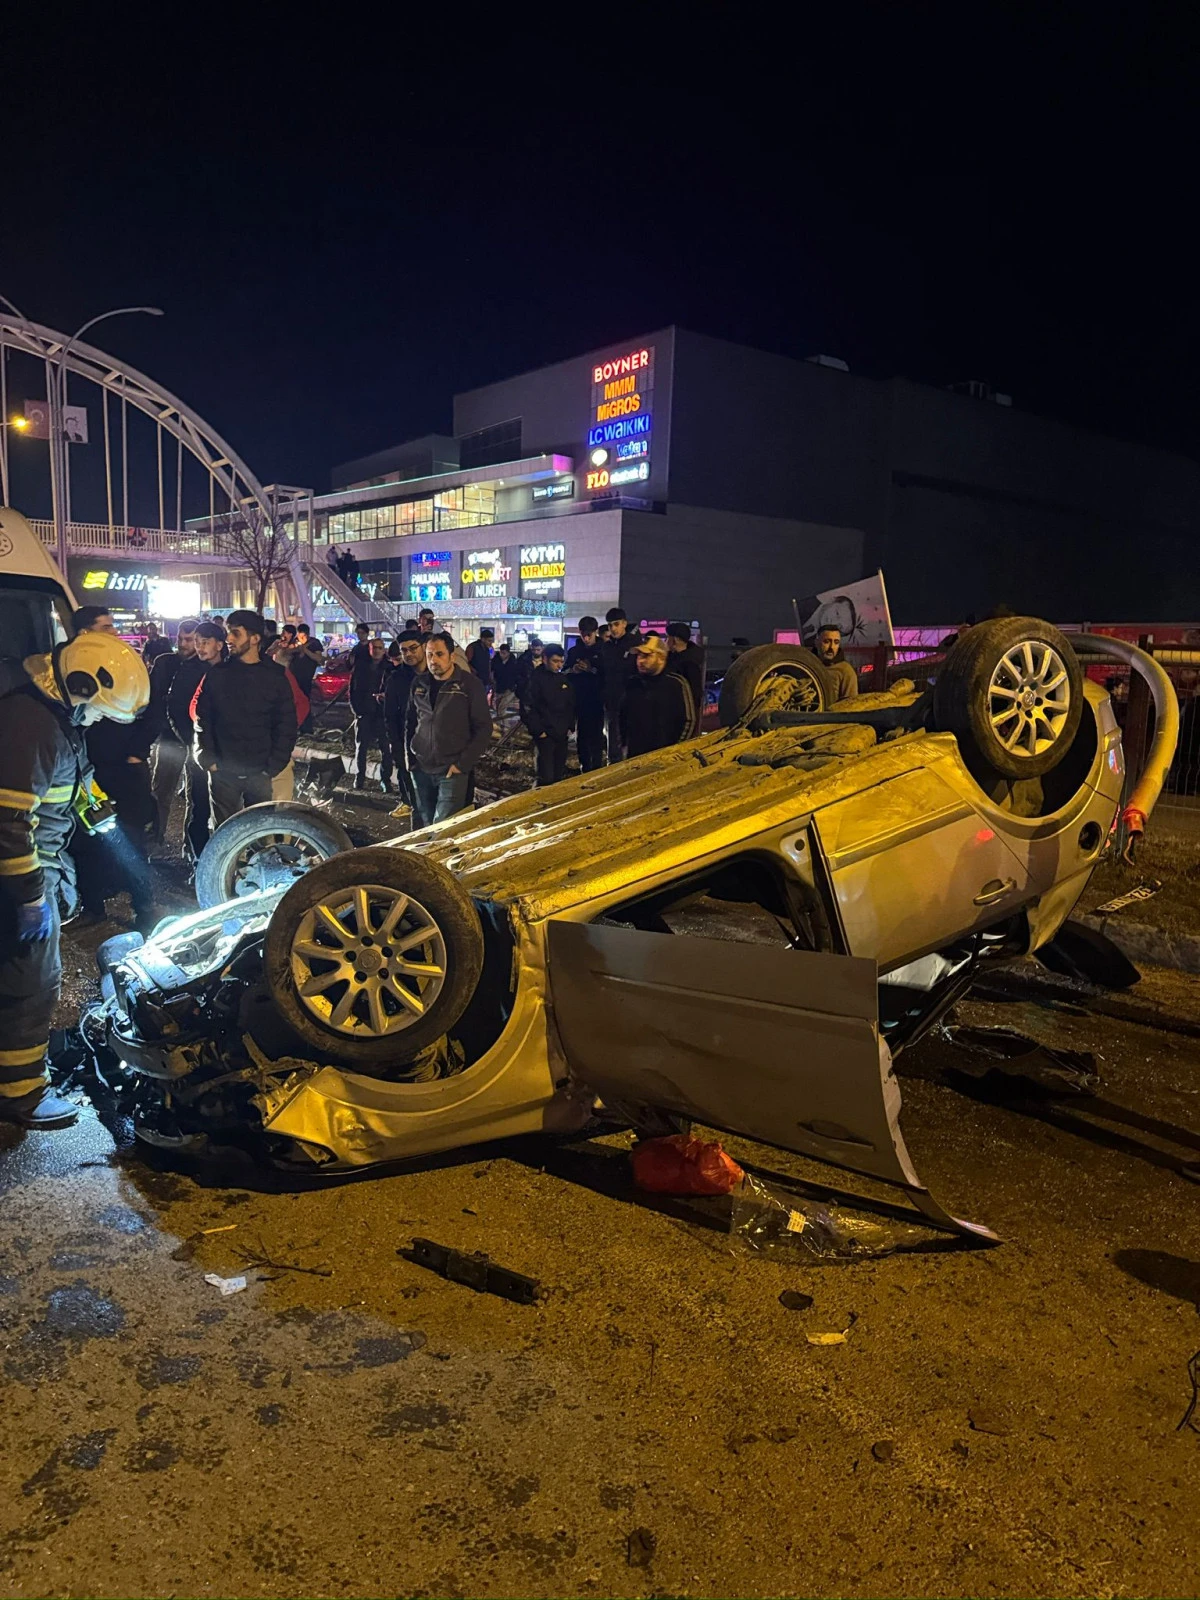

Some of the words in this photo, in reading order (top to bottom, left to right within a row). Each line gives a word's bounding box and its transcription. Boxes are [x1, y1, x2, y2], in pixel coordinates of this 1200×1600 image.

[594, 350, 649, 382] BOYNER
[604, 375, 635, 400] MMM
[589, 427, 602, 445] LC
[587, 470, 609, 489] FLO
[475, 584, 506, 597] NUREM
